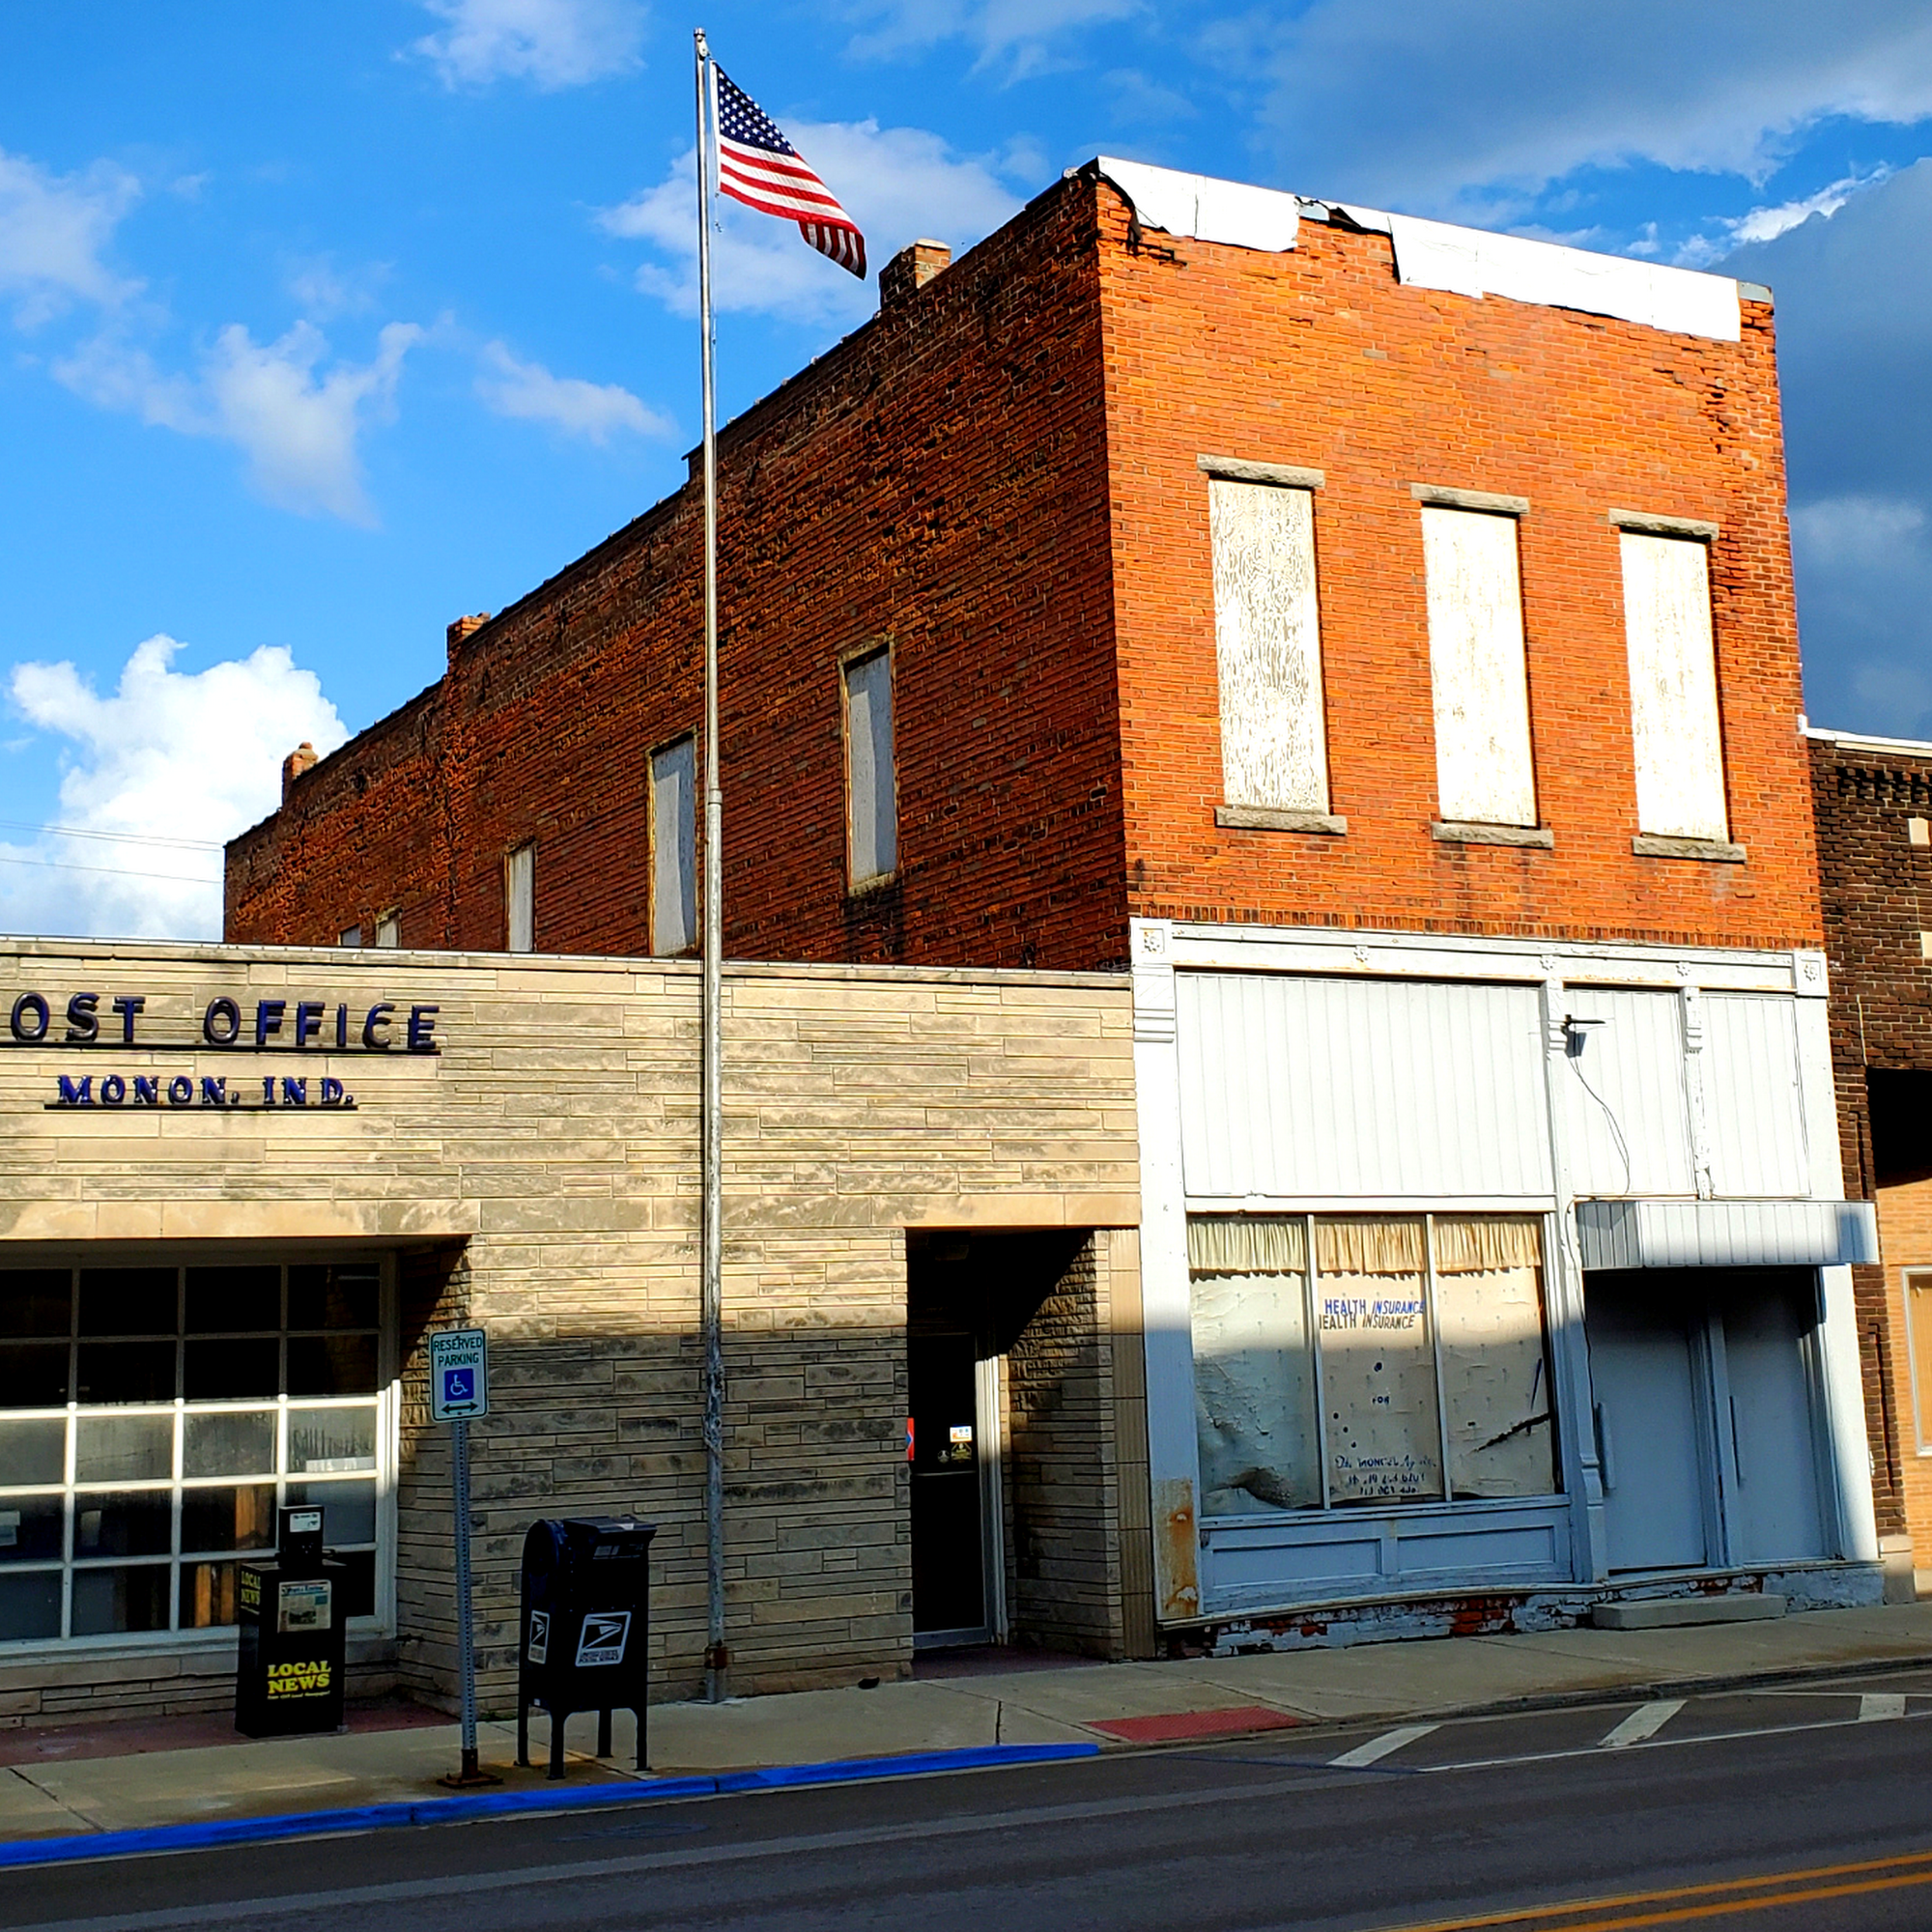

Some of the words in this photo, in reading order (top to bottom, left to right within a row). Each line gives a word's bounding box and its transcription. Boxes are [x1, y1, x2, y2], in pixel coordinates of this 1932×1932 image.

[11, 991, 146, 1043] OST
[203, 996, 440, 1049] OFFICE
[262, 1075, 355, 1105] IND.
[1324, 1298, 1366, 1315] HEALTH
[1372, 1299, 1426, 1314] INSURANCE
[434, 1337, 482, 1351] RESERVED
[439, 1353, 479, 1367] PARKING
[242, 1570, 261, 1590] LOCAL
[242, 1588, 260, 1605] NEWS
[268, 1661, 331, 1677] LOCAL
[268, 1673, 329, 1694] NEWS
